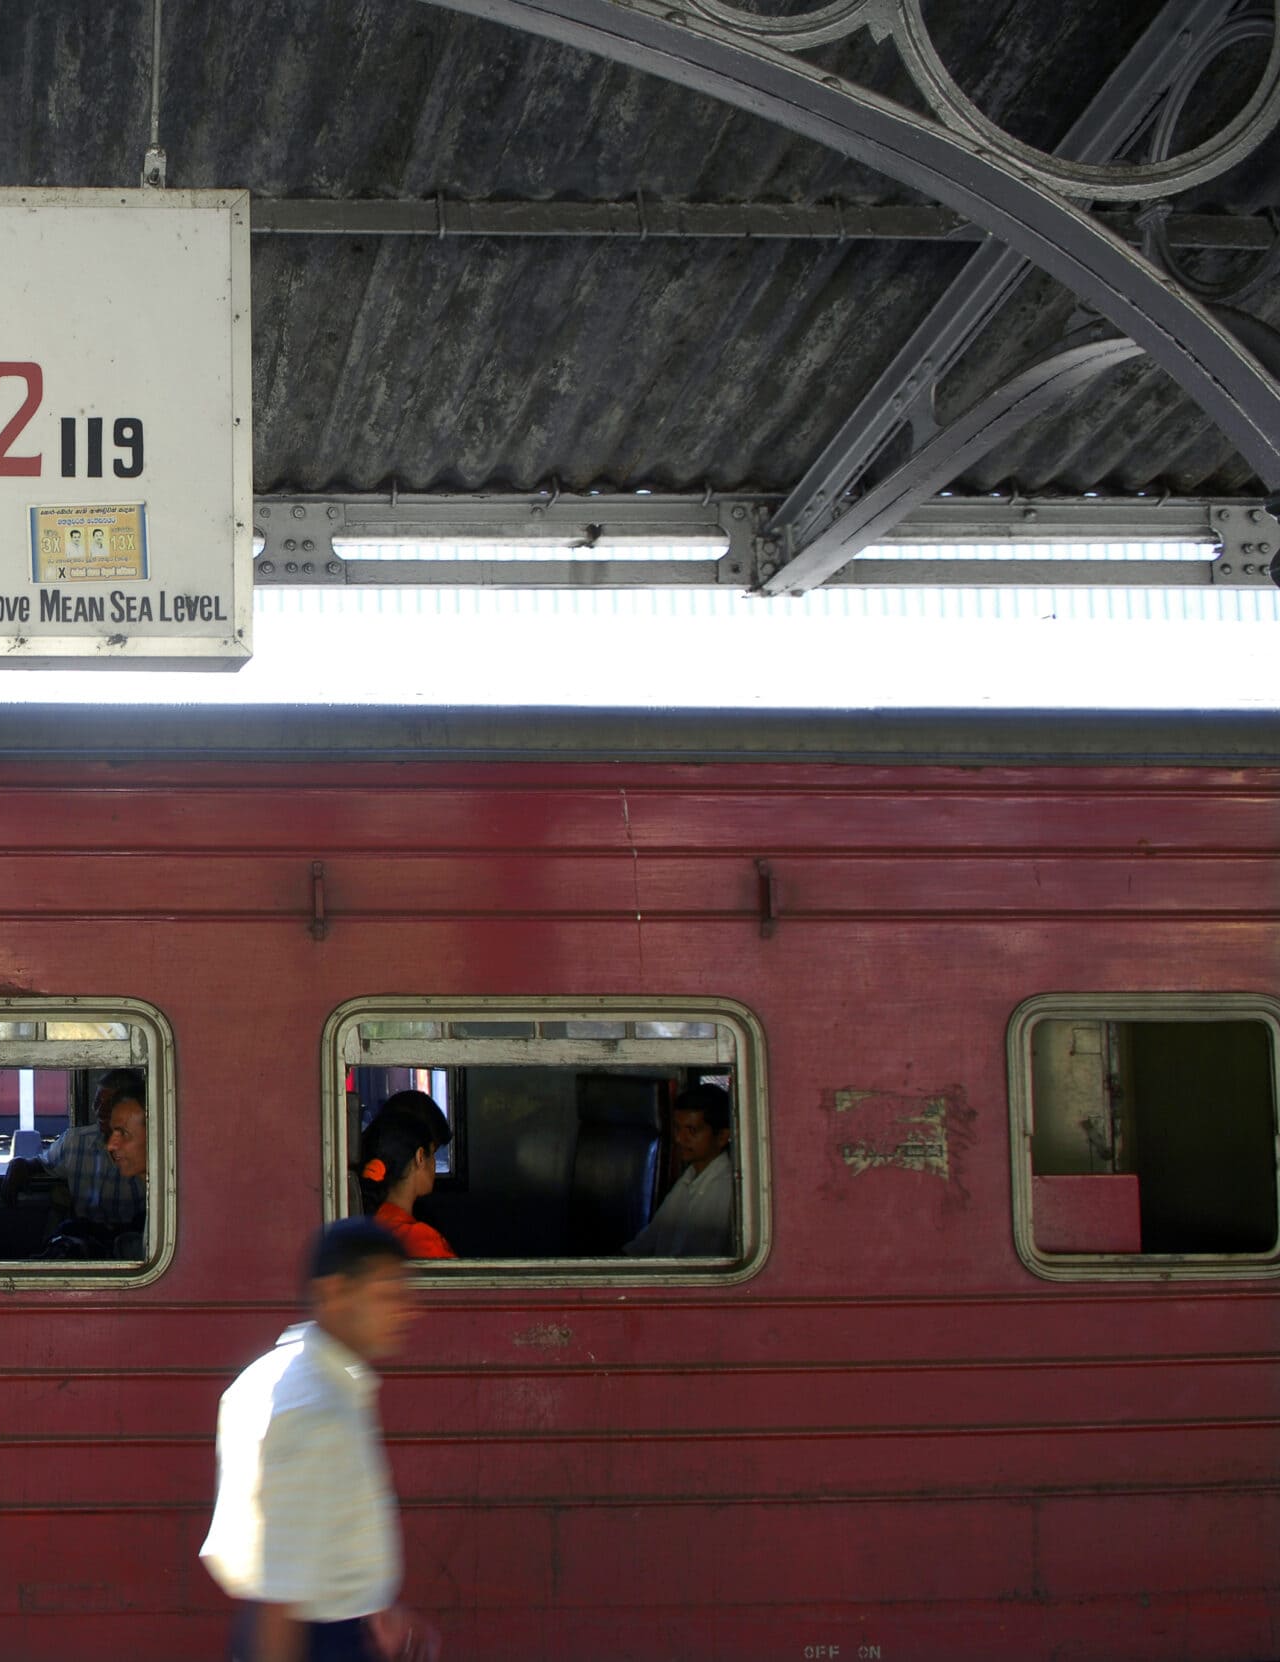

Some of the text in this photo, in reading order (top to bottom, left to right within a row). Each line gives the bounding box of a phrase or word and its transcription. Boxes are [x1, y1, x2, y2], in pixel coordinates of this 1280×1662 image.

[61, 417, 144, 478] 119
[40, 589, 105, 622] MEAN
[111, 590, 153, 622] SEA
[804, 1645, 881, 1659] OFF ON
